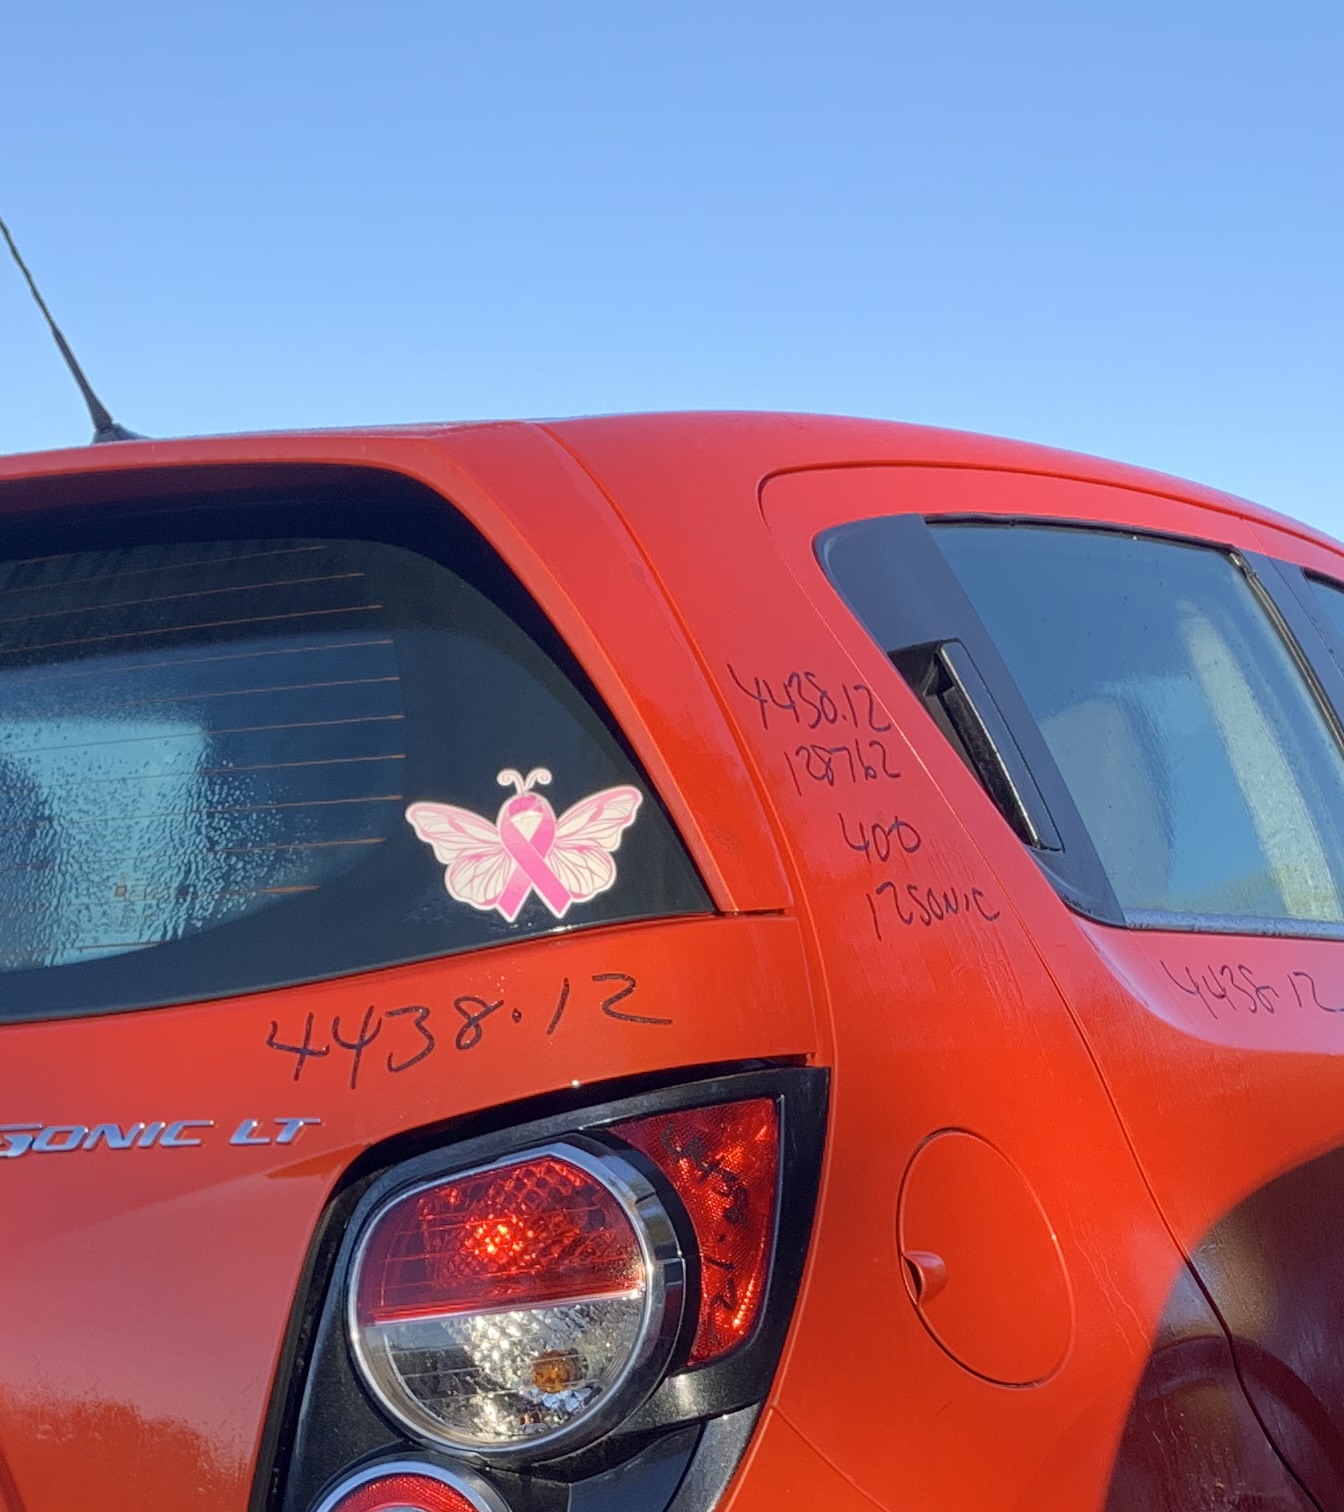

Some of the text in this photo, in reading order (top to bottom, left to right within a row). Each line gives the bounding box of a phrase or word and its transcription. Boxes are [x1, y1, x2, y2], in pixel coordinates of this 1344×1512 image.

[837, 812, 922, 864] 400
[265, 973, 674, 1091] 4438.12
[228, 1117, 326, 1146] LT
